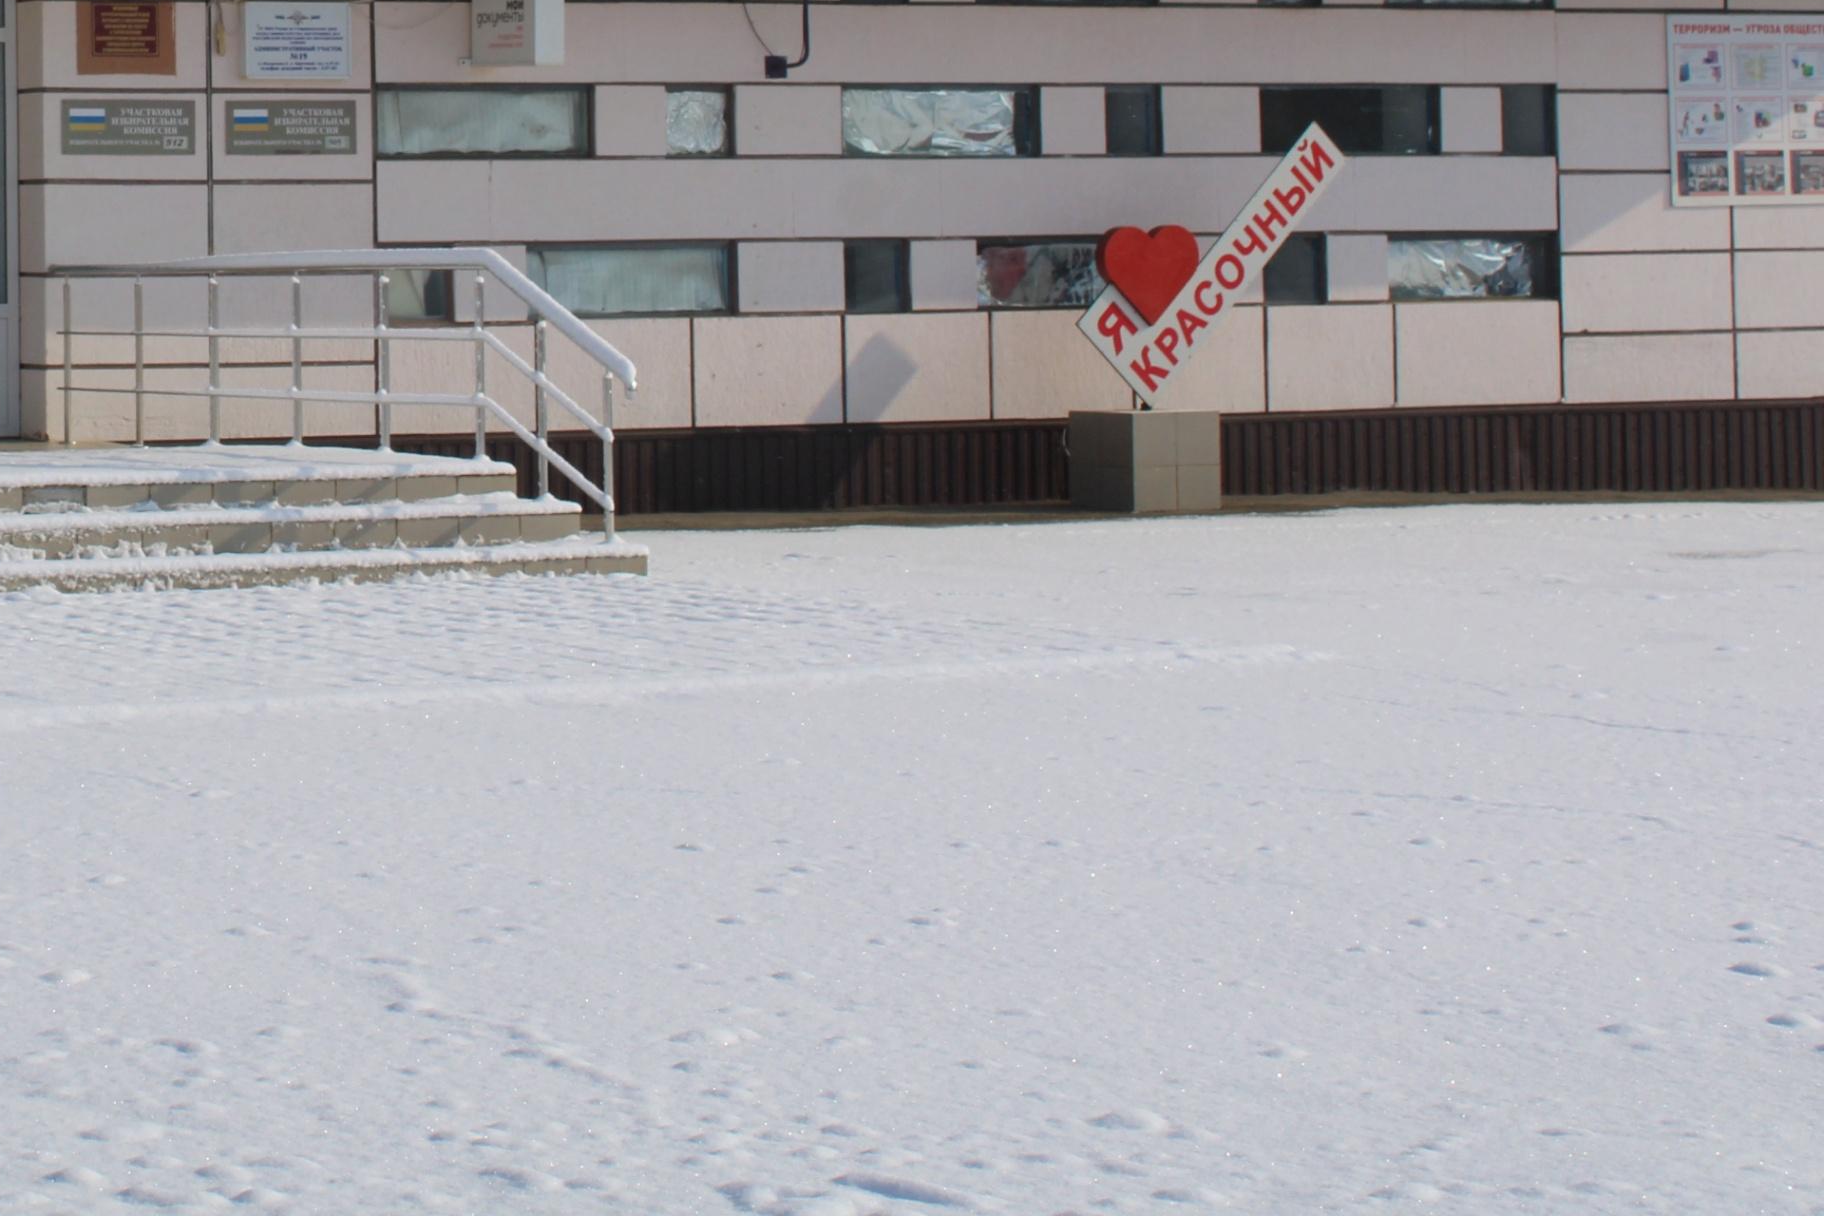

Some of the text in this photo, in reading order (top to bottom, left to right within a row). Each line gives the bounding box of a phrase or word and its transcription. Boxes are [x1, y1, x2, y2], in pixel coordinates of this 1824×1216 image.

[1673, 24, 1730, 34] ТЕРРОРИЗМ
[1746, 24, 1781, 34] УГРОЗА
[120, 107, 183, 117] УЧАСТКОВАЯ
[282, 108, 344, 117] УЧАСТКОВАЯ
[111, 117, 190, 126] ИЗБИРАТЕЛЬНАЯ
[274, 117, 351, 126] ИЗБИРАТЕЛЬНАЯ
[123, 126, 178, 135] КОМИССИЯ
[286, 126, 339, 135] КОМИССИЯ
[1129, 138, 1335, 393] КРАСОЧНЫЙ
[1097, 301, 1138, 356] Я
